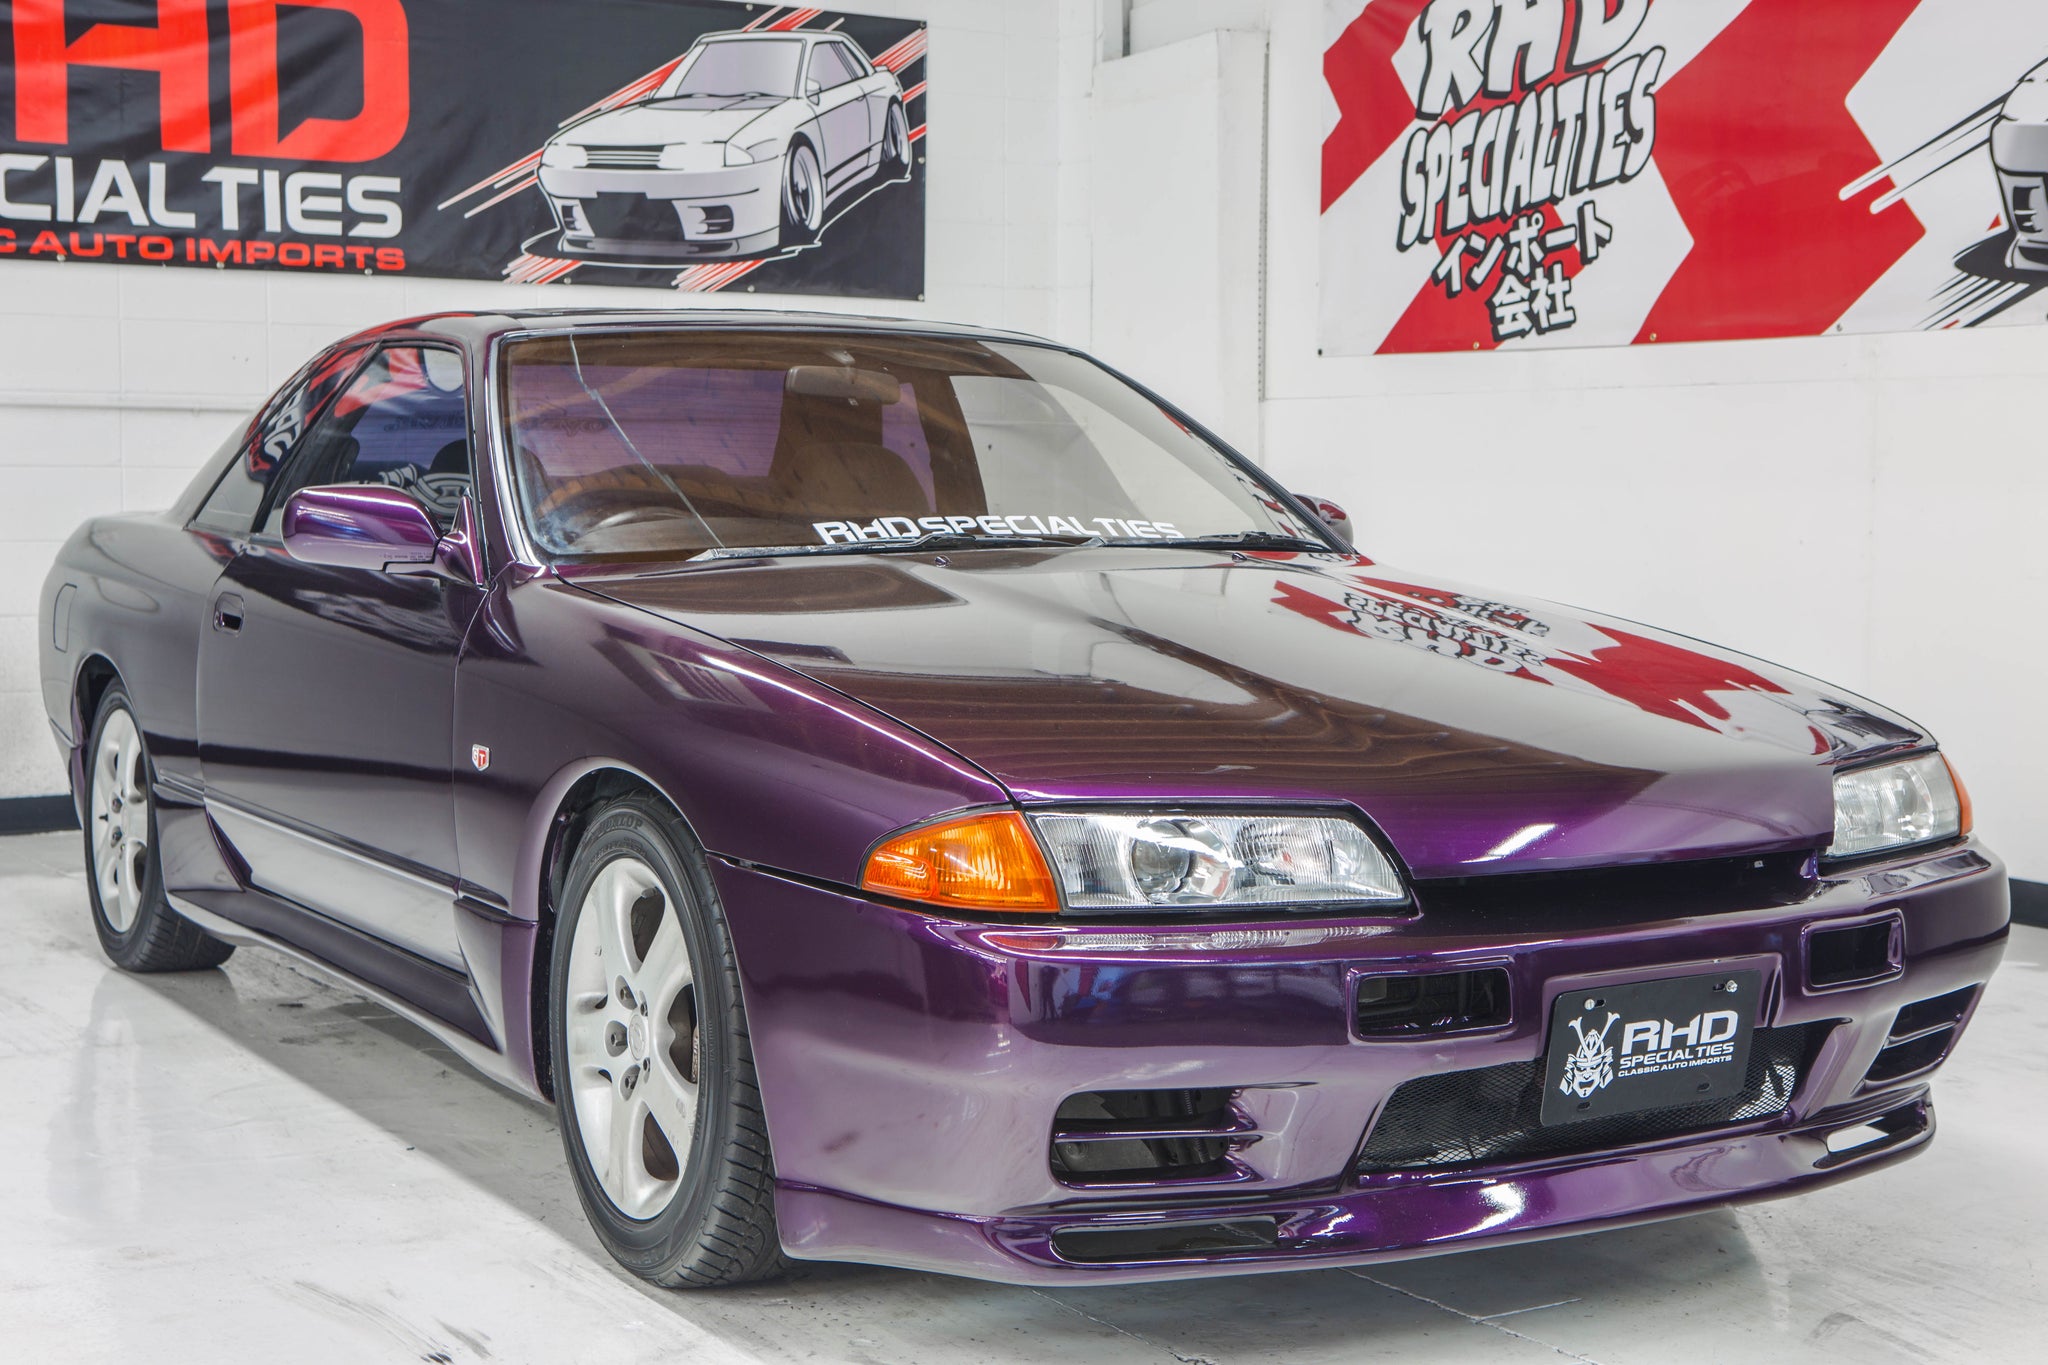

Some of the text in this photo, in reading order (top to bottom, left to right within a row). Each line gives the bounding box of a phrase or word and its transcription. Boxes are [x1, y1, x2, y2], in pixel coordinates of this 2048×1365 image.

[1415, 0, 1649, 120] RHD
[1397, 46, 1666, 252] SPECIALTIES
[29, 230, 174, 260] AUTO
[186, 238, 406, 271] IMPORTS
[1433, 200, 1613, 298] インポート
[1486, 260, 1577, 341] 会社
[1619, 1042, 1735, 1070] SPECIALTIES
[1621, 1010, 1738, 1055] RHD
[1618, 1055, 1733, 1078] CLASSIC AUTO IMPORTS
